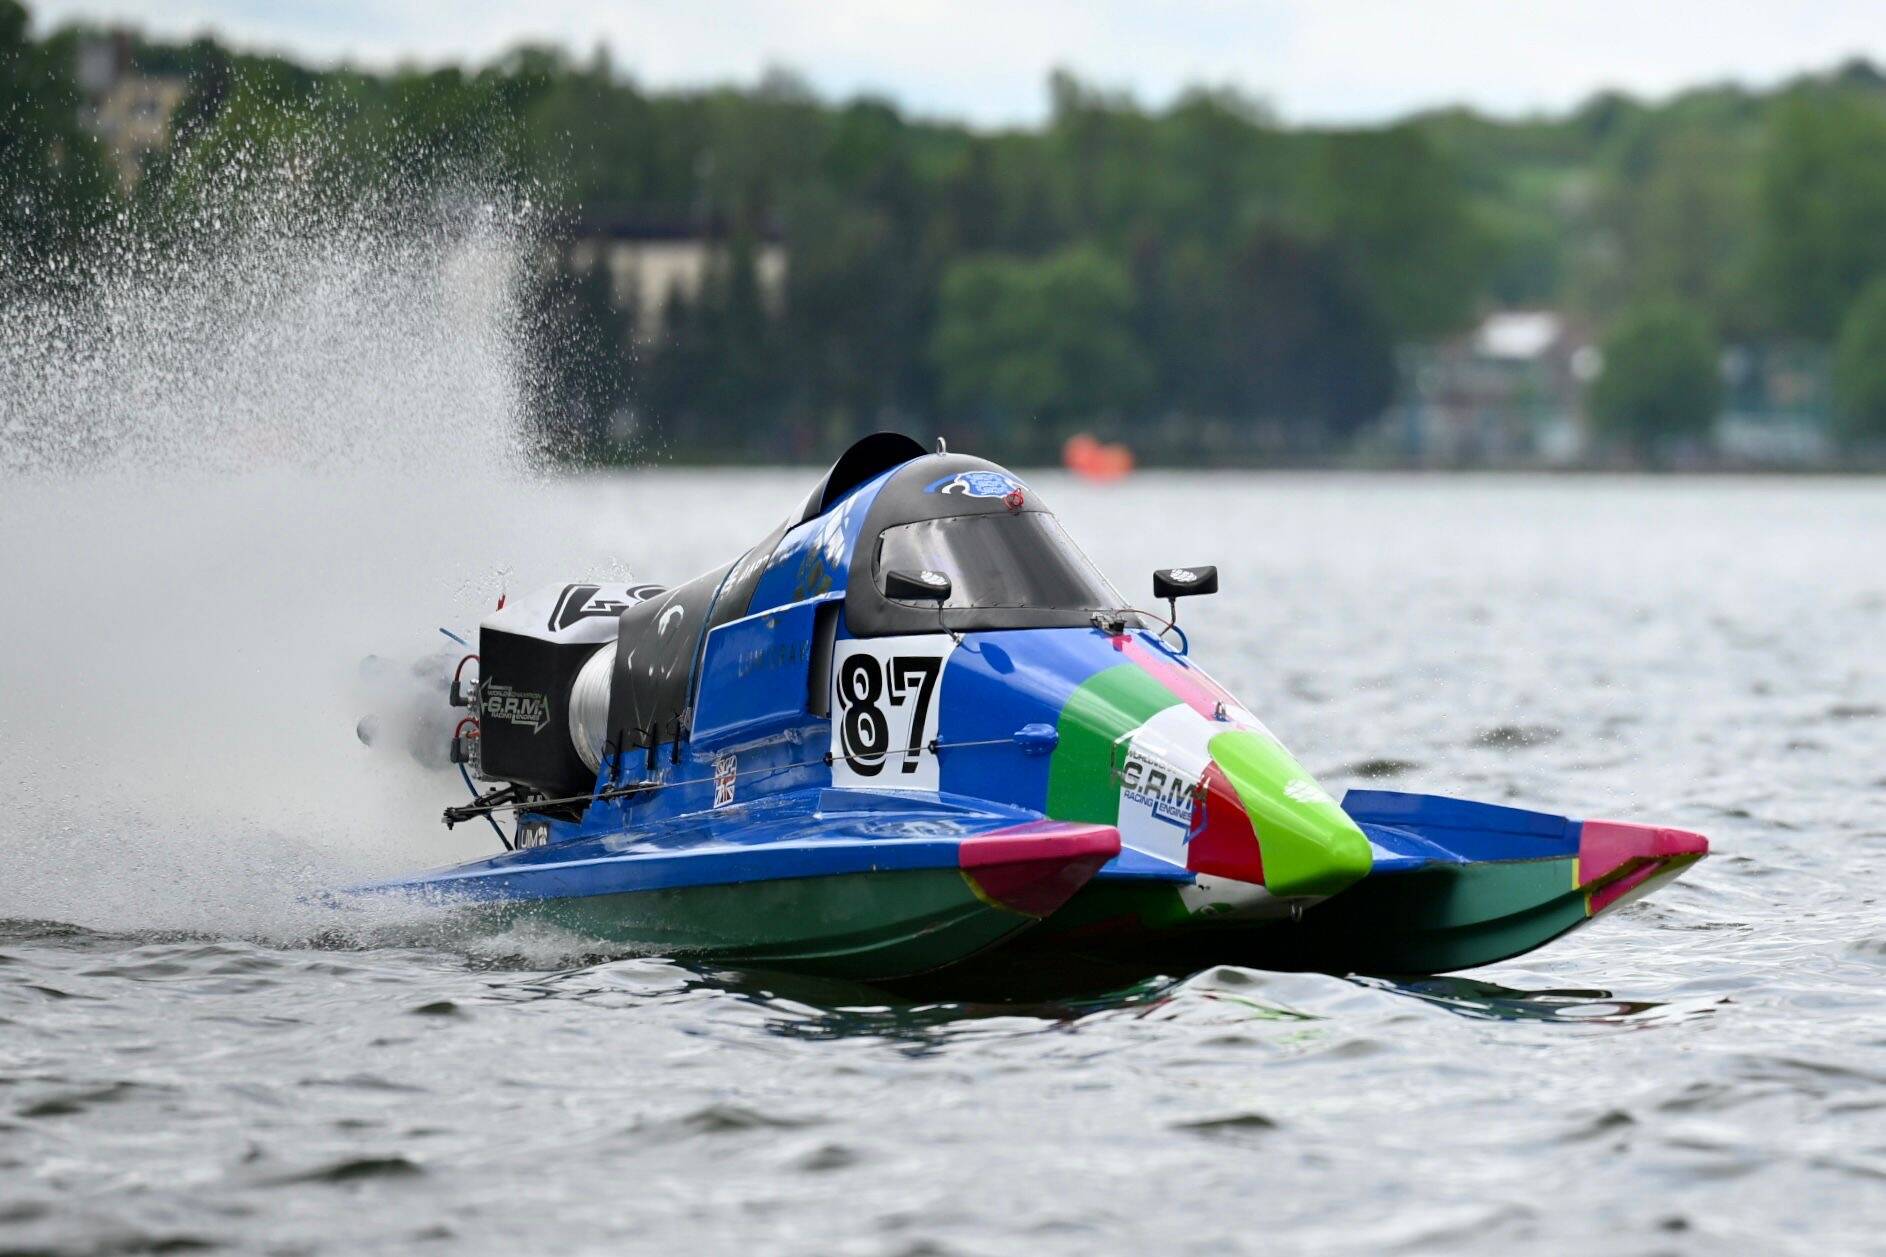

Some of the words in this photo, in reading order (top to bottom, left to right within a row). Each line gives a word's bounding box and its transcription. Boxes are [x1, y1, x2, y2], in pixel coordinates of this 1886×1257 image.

[836, 653, 943, 777] 87
[1124, 790, 1154, 808] RACING
[1158, 802, 1193, 822] ENGINES
